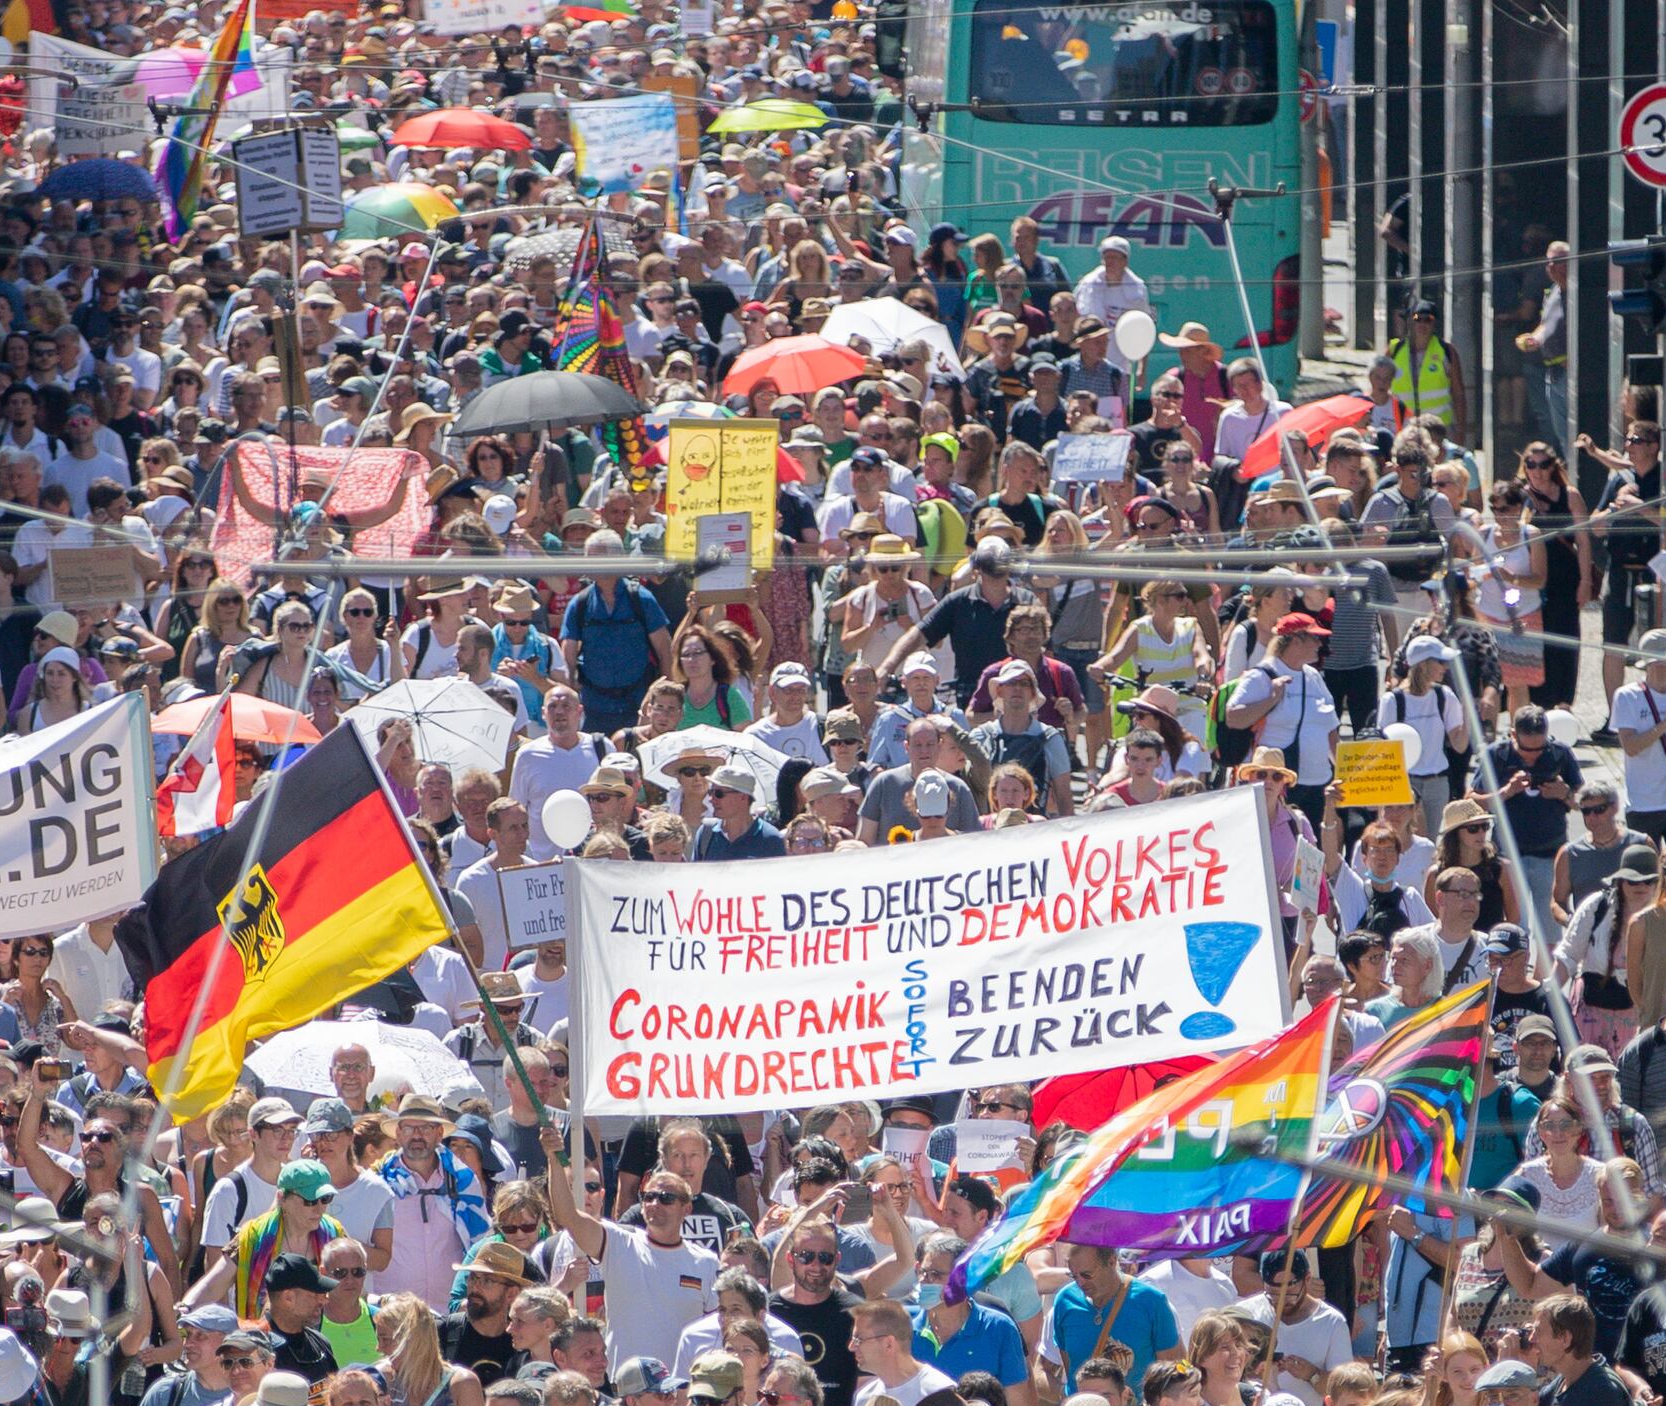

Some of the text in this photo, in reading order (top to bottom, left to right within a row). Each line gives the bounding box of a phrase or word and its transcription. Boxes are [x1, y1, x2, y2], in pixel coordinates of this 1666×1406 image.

[1011, 188, 1233, 250] AFAN
[42, 887, 62, 906] ZU
[65, 869, 125, 904] WERDEN
[525, 876, 548, 901] Für
[611, 821, 1221, 936] ZUM WOHLE DES DEUTSCHEN VOLKES
[523, 911, 547, 936] und
[649, 864, 1230, 975] FÜR FREIHEIT UND DEMOKRATIE
[947, 953, 1145, 1018] BEENDEN
[950, 1001, 1173, 1065] ZURÜCK
[606, 1039, 916, 1100] GRUNDRECHTE
